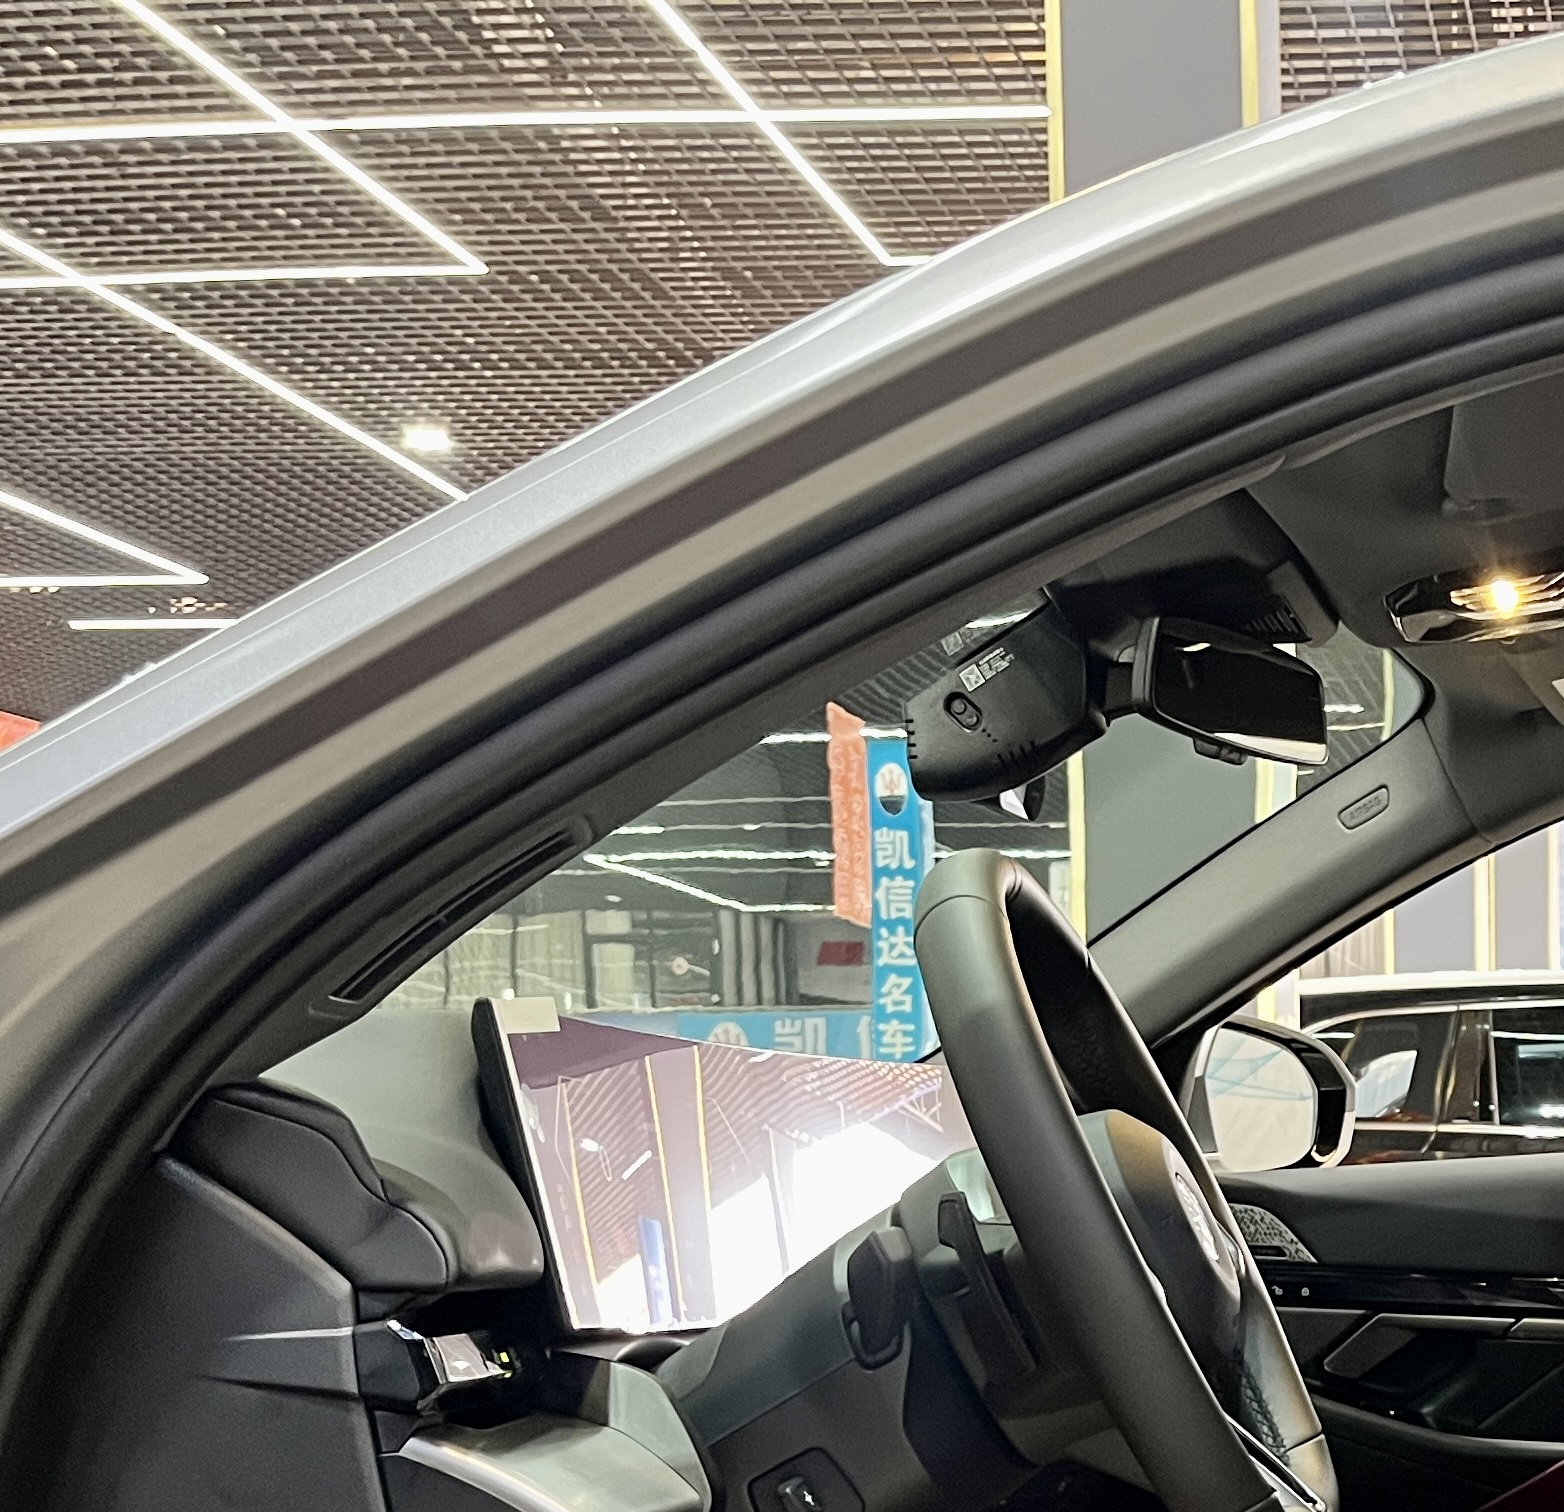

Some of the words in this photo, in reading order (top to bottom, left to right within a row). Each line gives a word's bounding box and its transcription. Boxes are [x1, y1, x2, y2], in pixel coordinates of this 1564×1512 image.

[874, 826, 916, 1060] 凯信达名车
